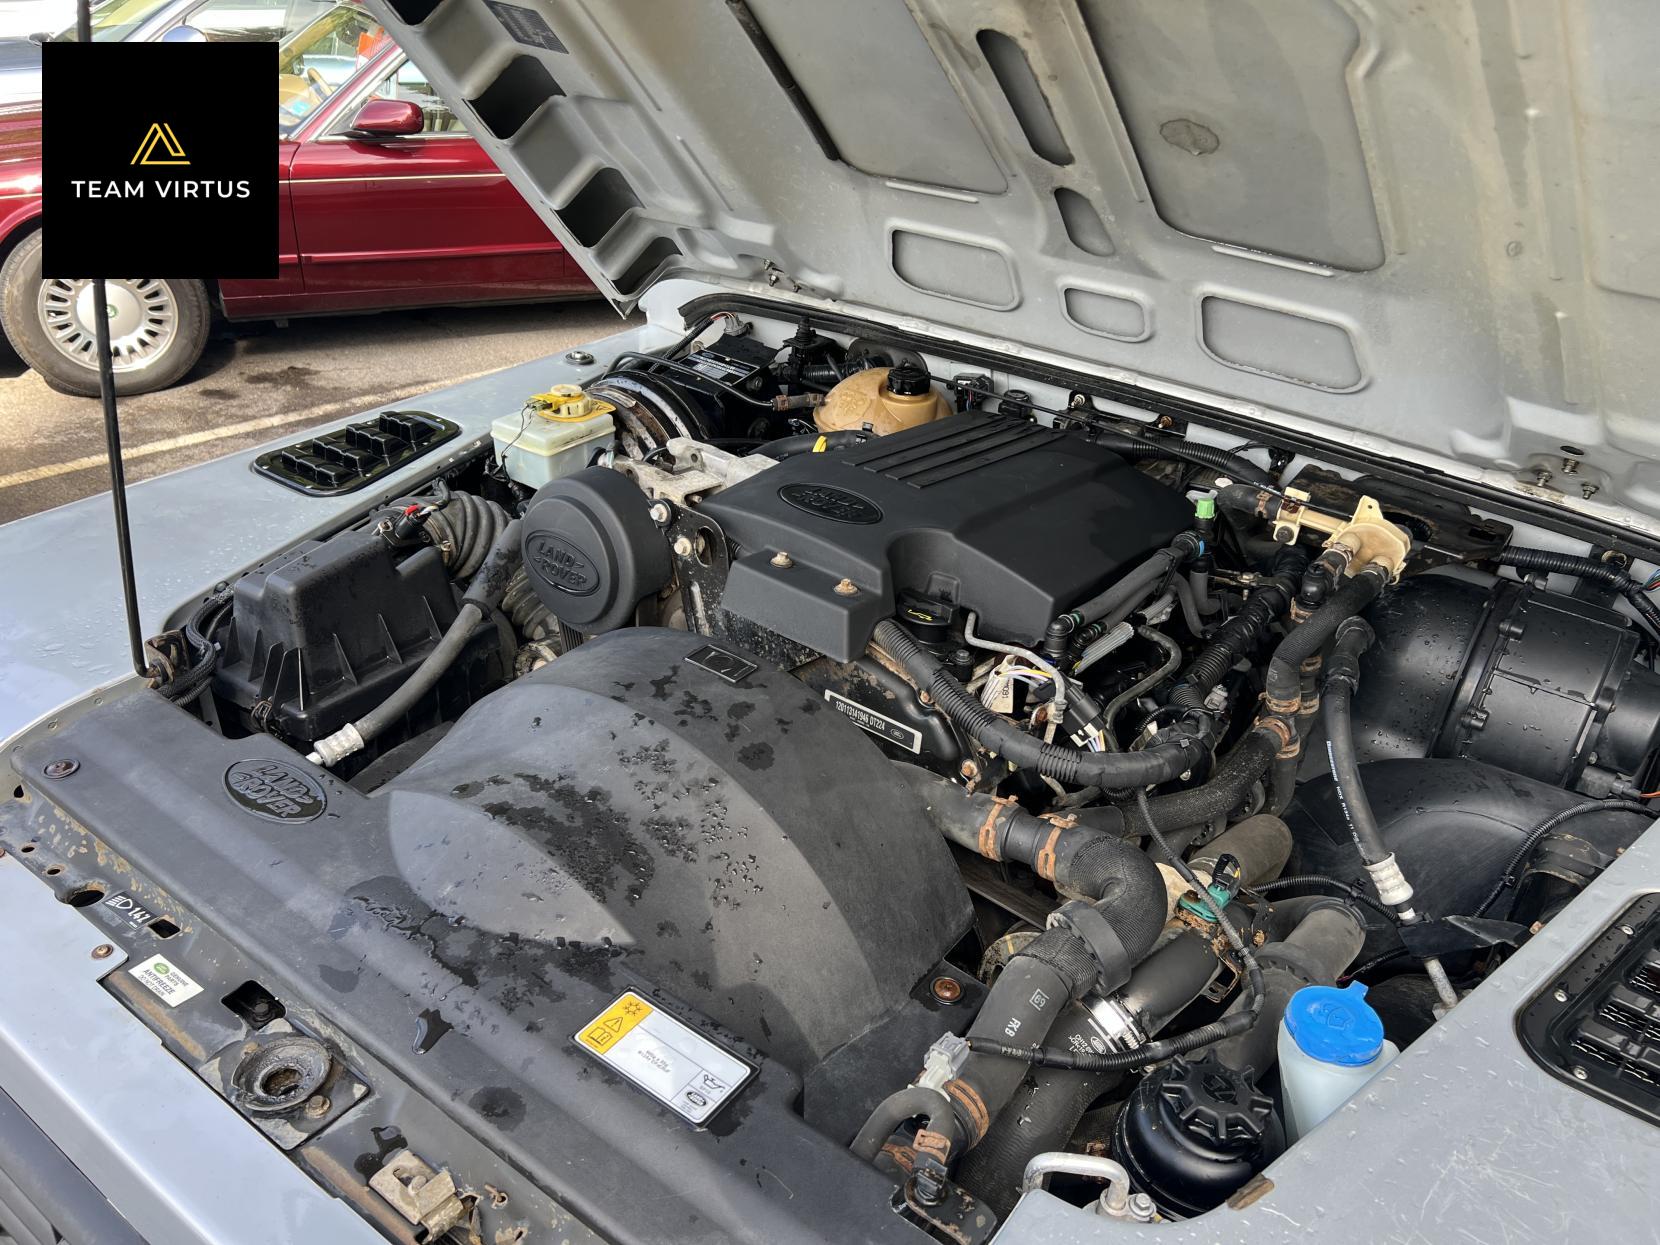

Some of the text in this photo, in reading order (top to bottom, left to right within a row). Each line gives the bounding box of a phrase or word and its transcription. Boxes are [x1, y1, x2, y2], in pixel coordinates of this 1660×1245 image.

[538, 541, 578, 569] LAND
[540, 557, 588, 588] ROVER
[240, 776, 302, 818] ROVER
[252, 765, 311, 799] LAND
[143, 968, 176, 996] ANTIFREEZE
